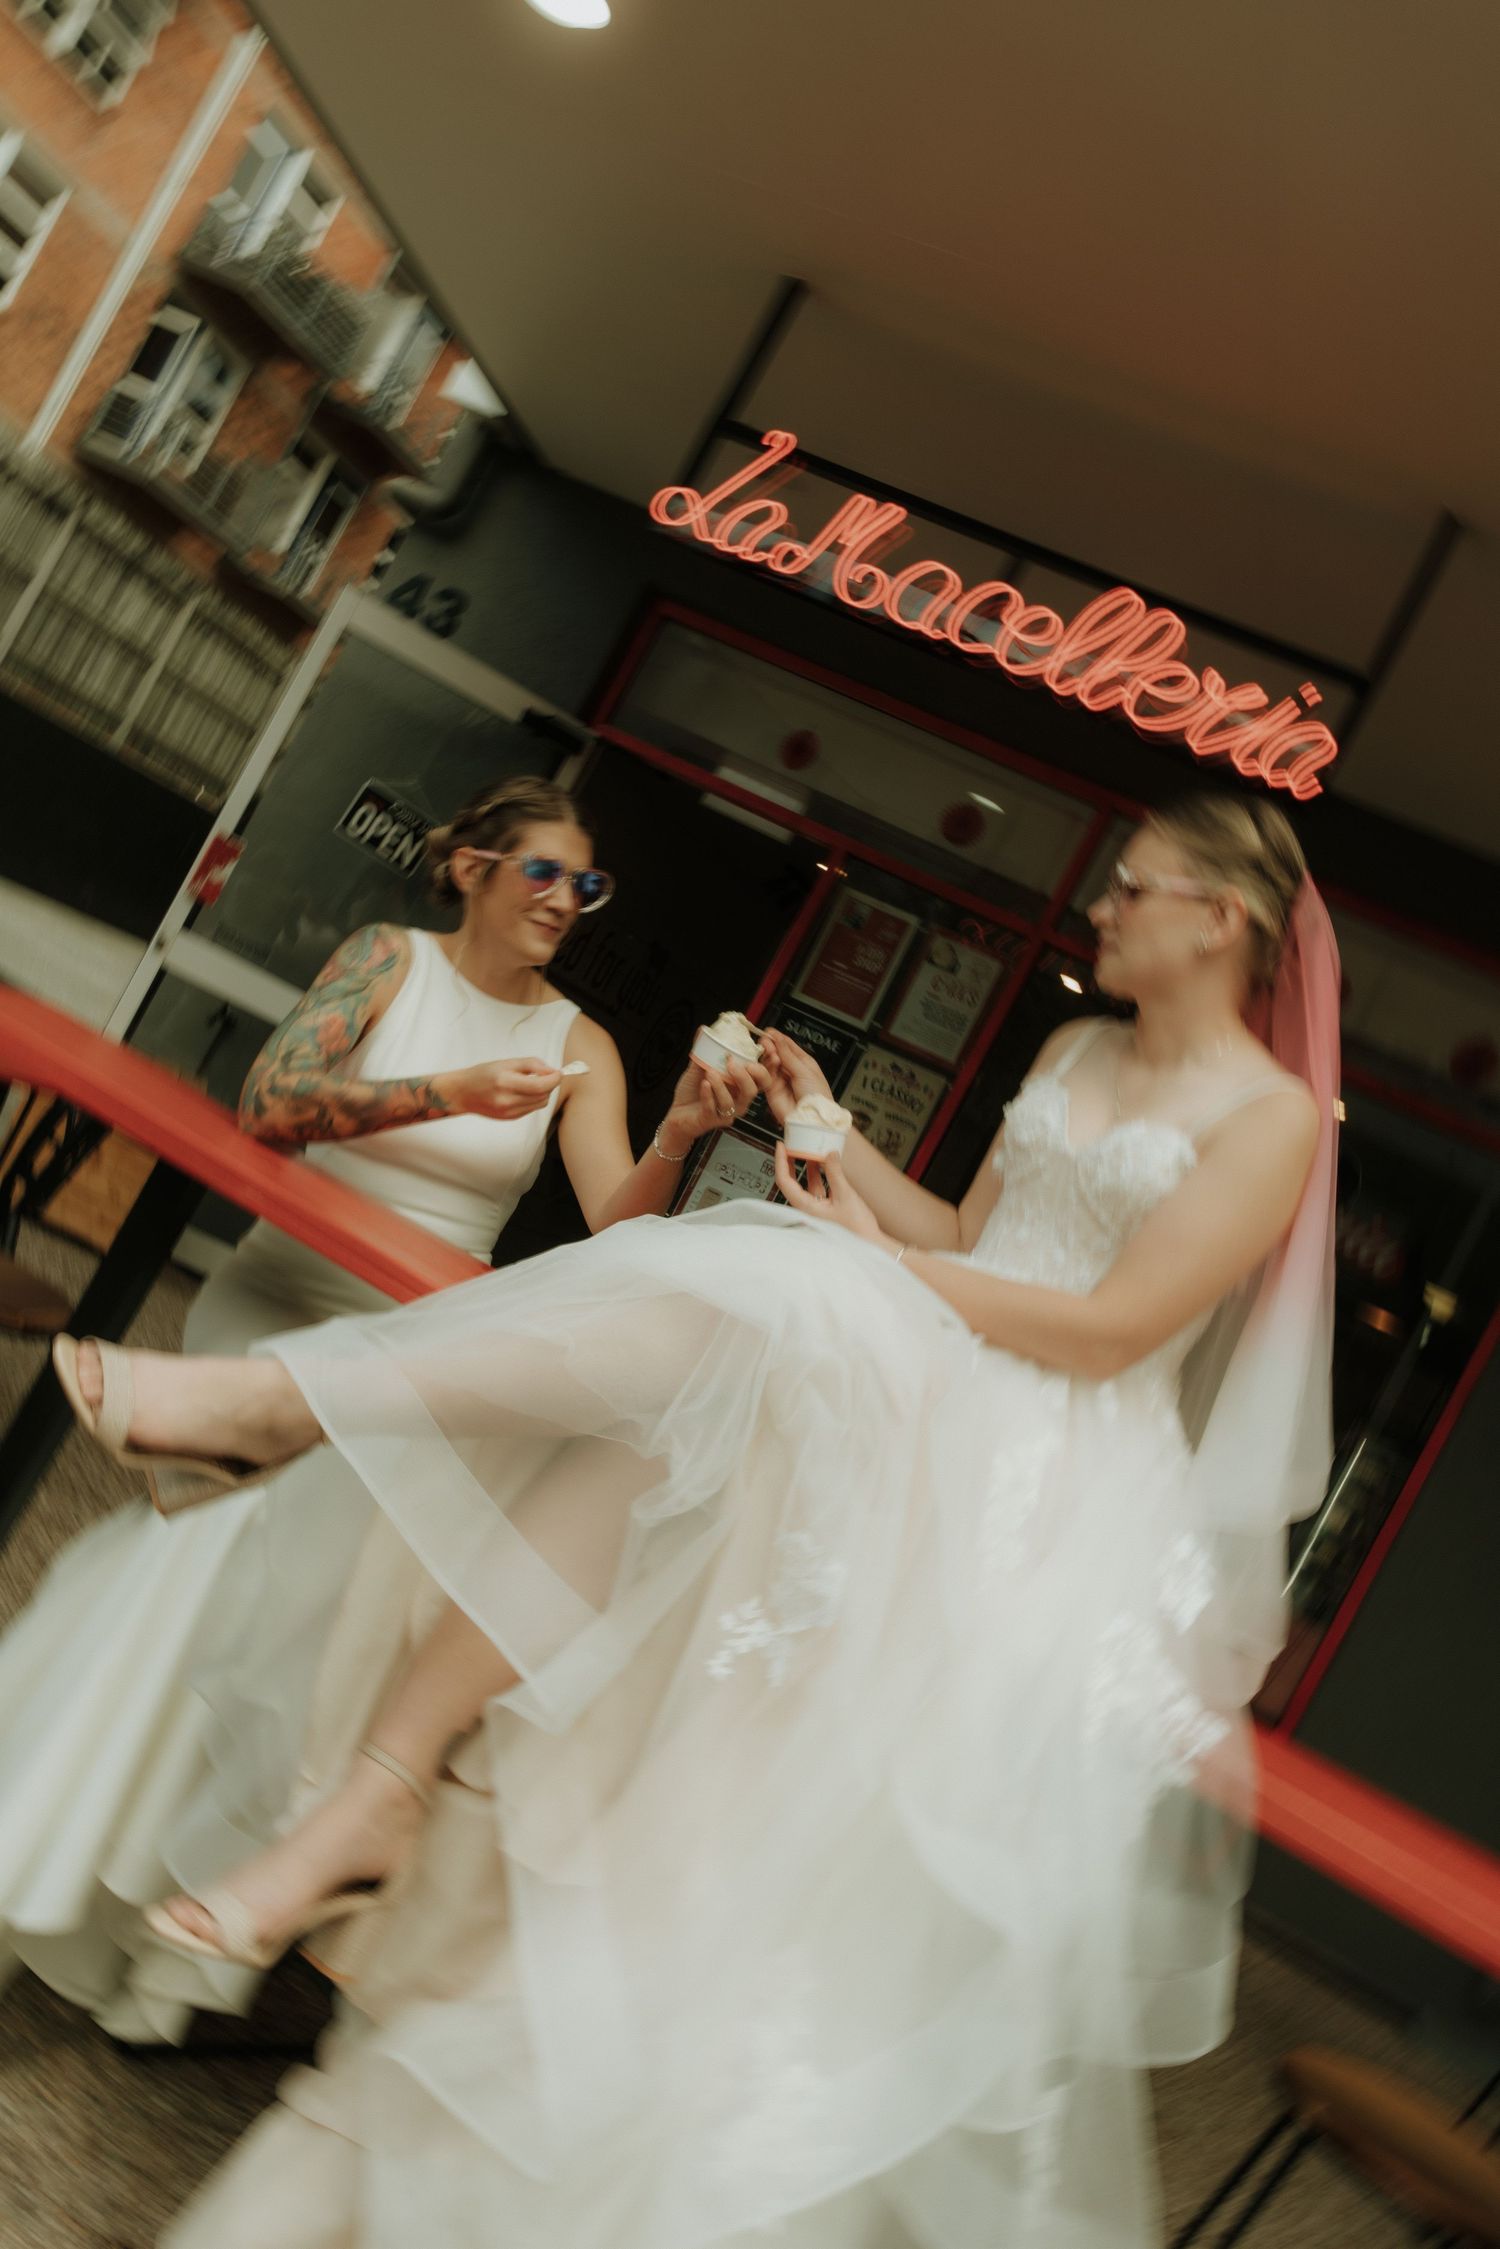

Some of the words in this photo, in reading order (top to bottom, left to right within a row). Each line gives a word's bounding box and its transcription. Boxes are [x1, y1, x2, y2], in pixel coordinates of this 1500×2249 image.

[385, 573, 472, 640] 43
[648, 430, 797, 563] La
[767, 494, 1338, 800] Macelleria
[346, 801, 425, 870] OPEN
[784, 1019, 842, 1056] SUNDAE
